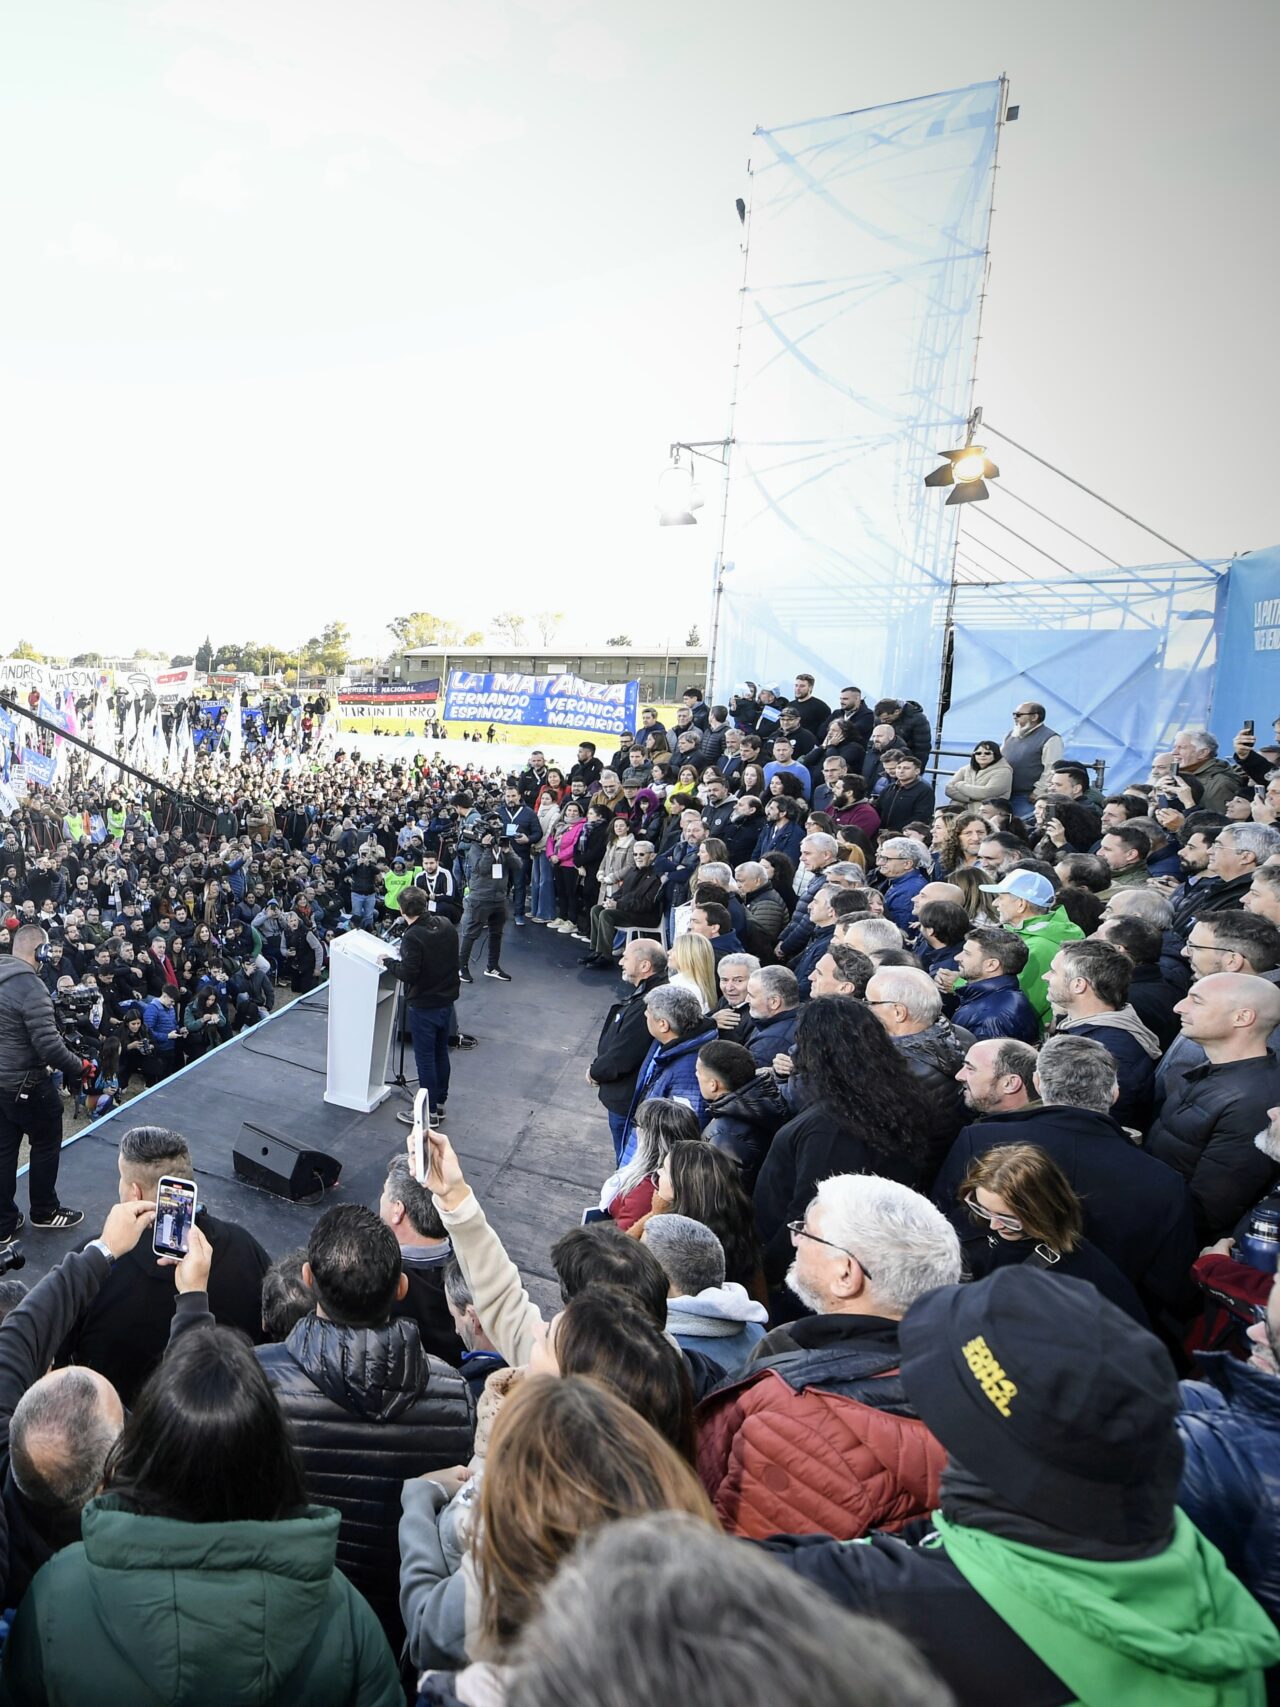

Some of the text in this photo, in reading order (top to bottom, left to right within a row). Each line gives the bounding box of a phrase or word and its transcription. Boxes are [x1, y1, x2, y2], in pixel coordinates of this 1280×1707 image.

[0, 664, 43, 684] ANDRES
[48, 671, 97, 690] WATSON
[337, 685, 417, 695] CORRIENTE NACIONAL
[451, 671, 627, 704] LA MATANZA
[448, 691, 531, 707] FERNANDO
[449, 705, 524, 722] ESPINOZA
[548, 712, 625, 732] MAGARIO
